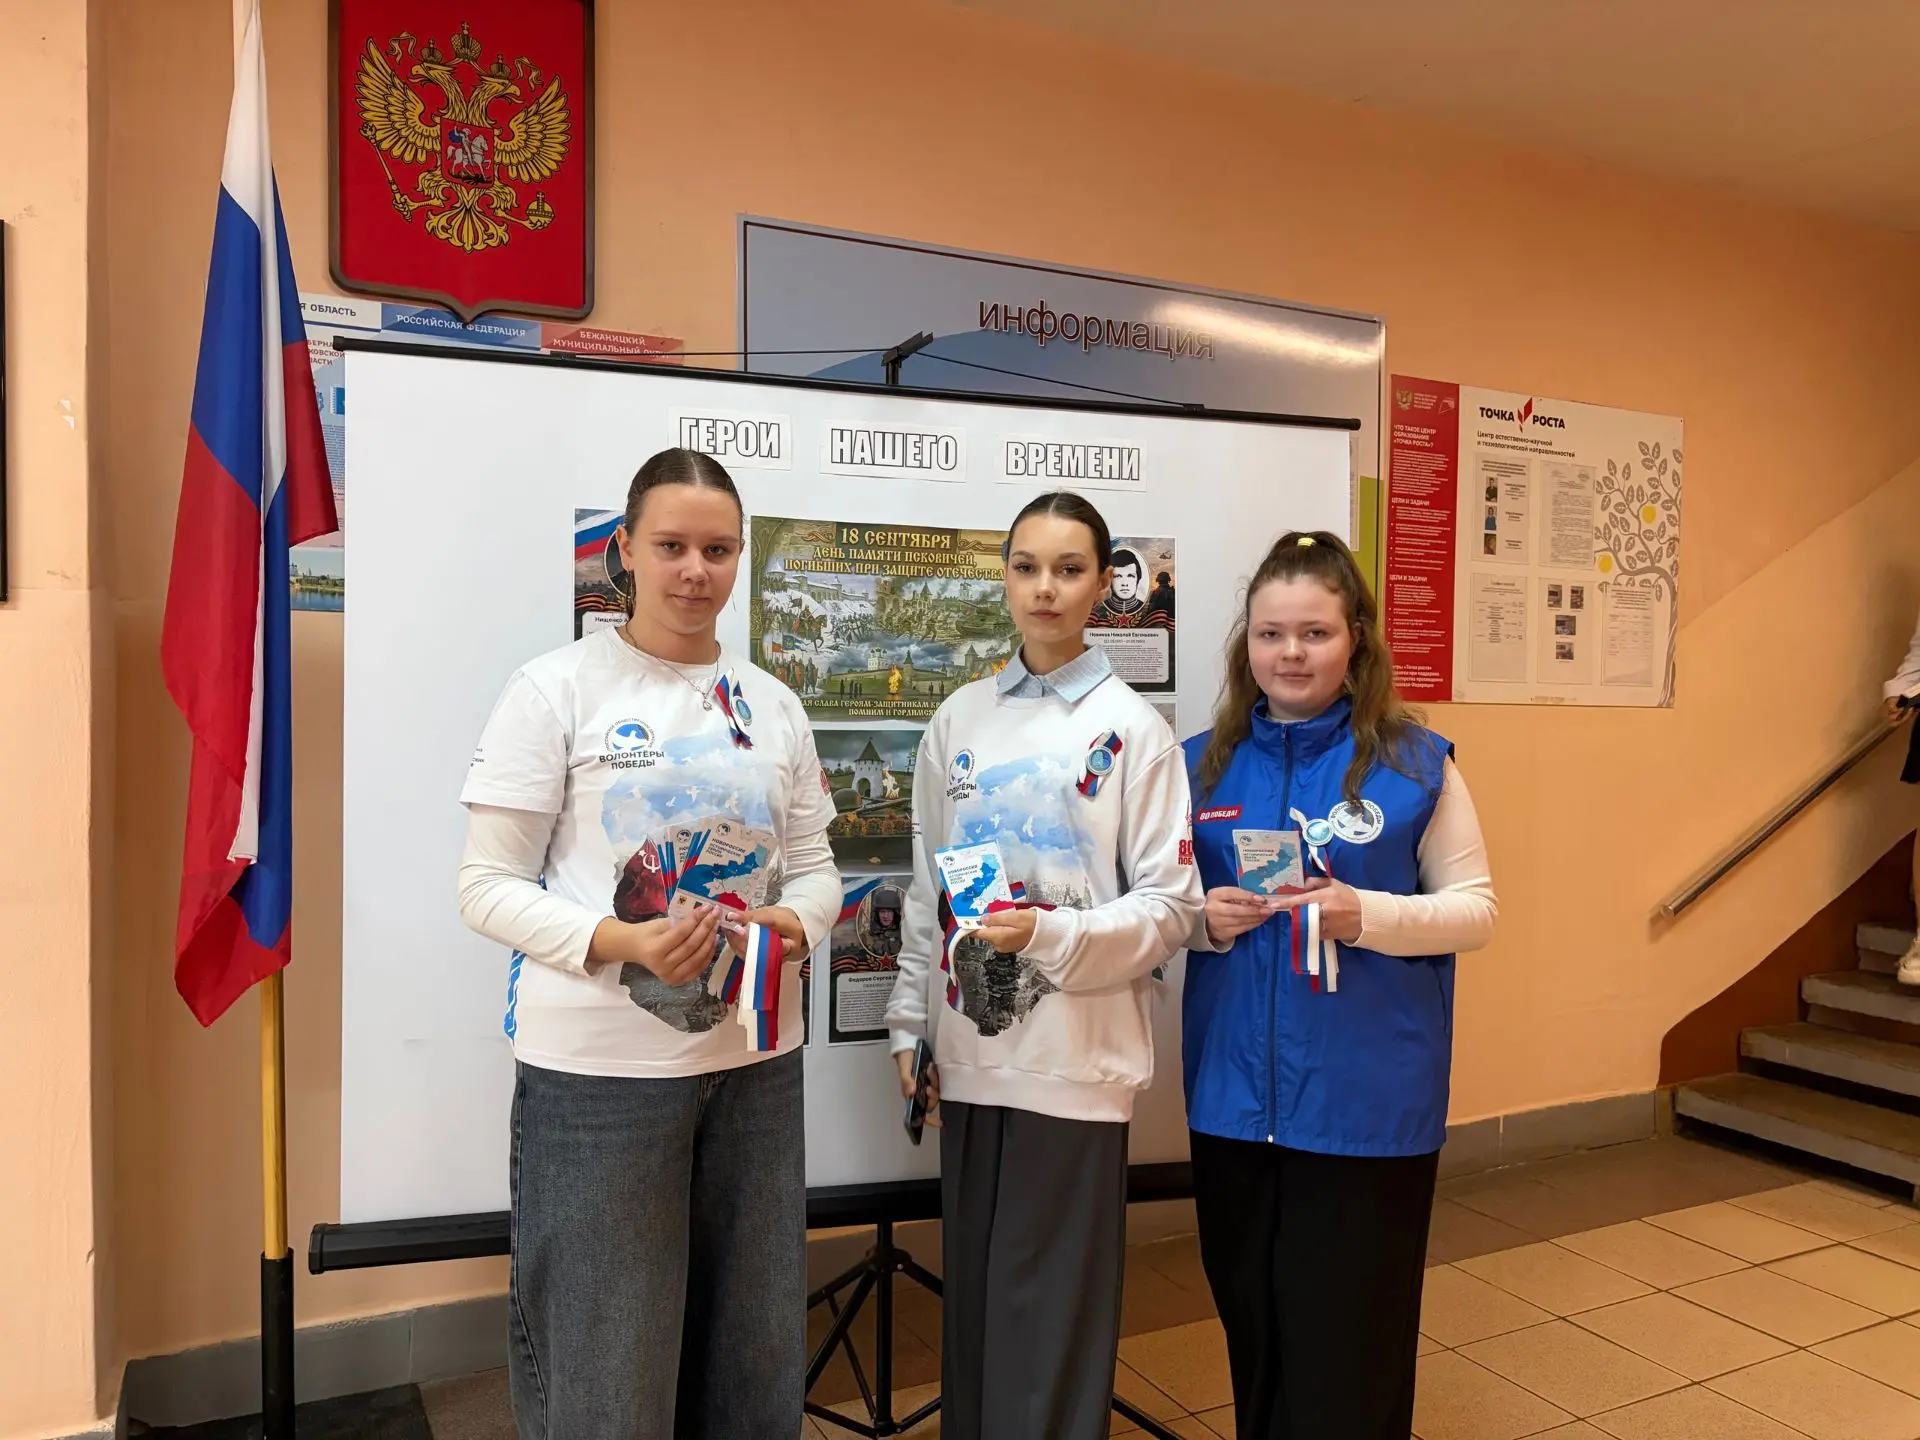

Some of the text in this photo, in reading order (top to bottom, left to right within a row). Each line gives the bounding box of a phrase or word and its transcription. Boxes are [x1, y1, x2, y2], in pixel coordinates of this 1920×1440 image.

[310, 303, 357, 317] ОБЛАСТЬ
[396, 314, 526, 337] РОССИЙСКАЯ ФЕДЕРАЦИЯ
[553, 338, 641, 355] МУНИЦИПАЛЬНЫЙ
[580, 331, 646, 346] БЕЖАНИЦКИЙ
[1479, 406, 1566, 430] ТОЧКА РОСТА
[1477, 430, 1553, 447] Центр естественно-научной
[679, 416, 1141, 482] ГЕРОИ НАШЕГО ВРЕМЕНИ
[1482, 441, 1528, 452] технологической
[1529, 448, 1576, 458] направленностей
[841, 528, 952, 549] 18 СЕНТЯБРЯ
[812, 546, 978, 568] ДЕНЬ ПАМЯТИ ПСКОВИЧЕЙ,
[784, 559, 1005, 581] ПОГИБШИХ ПРИ ЗАЩИТЕ ОТЕЧЕСТВА
[814, 699, 839, 708] СЛАВА
[840, 699, 929, 709] ГЕРОЯМ-ЗАЩИТНИКАМ
[848, 708, 884, 716] ПОМНИМ
[598, 750, 665, 763] ВОЛОНТЁРЫ
[611, 759, 655, 770] ПОБЕДЫ
